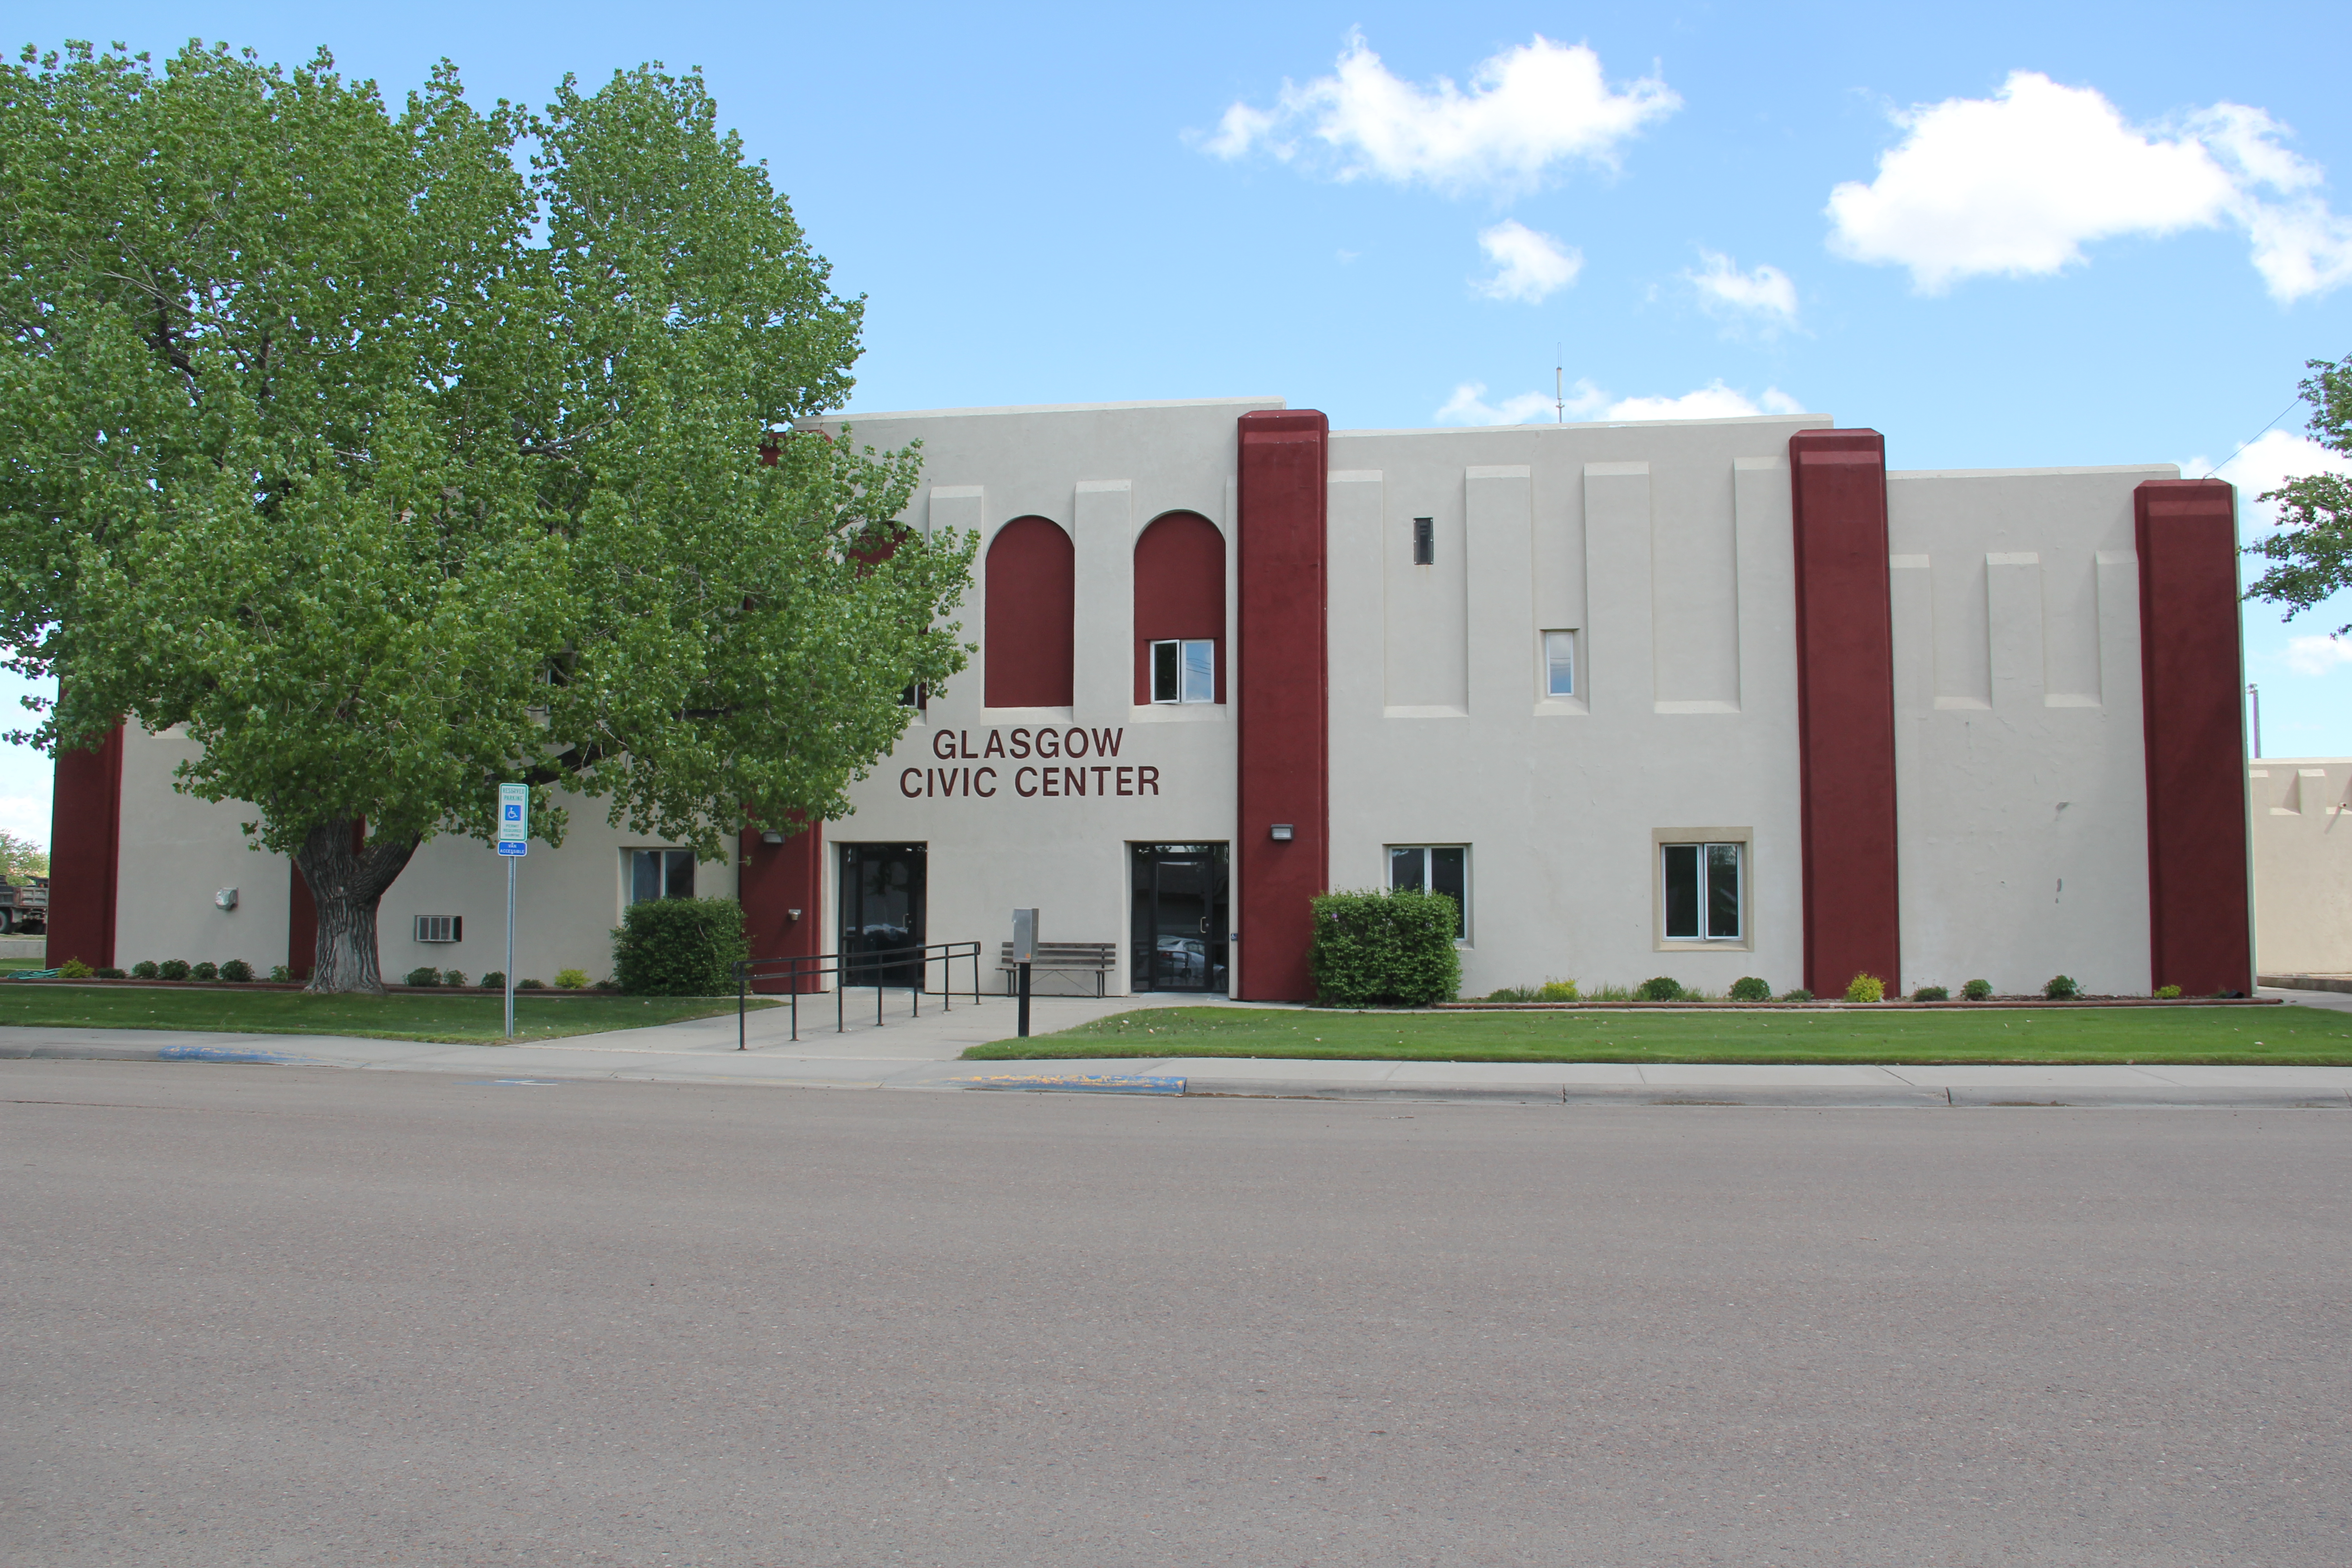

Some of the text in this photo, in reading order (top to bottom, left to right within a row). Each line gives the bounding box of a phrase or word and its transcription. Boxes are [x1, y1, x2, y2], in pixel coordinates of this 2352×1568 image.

[933, 728, 1123, 760] GLASGOW
[900, 766, 1159, 798] CIVIC CENTER
